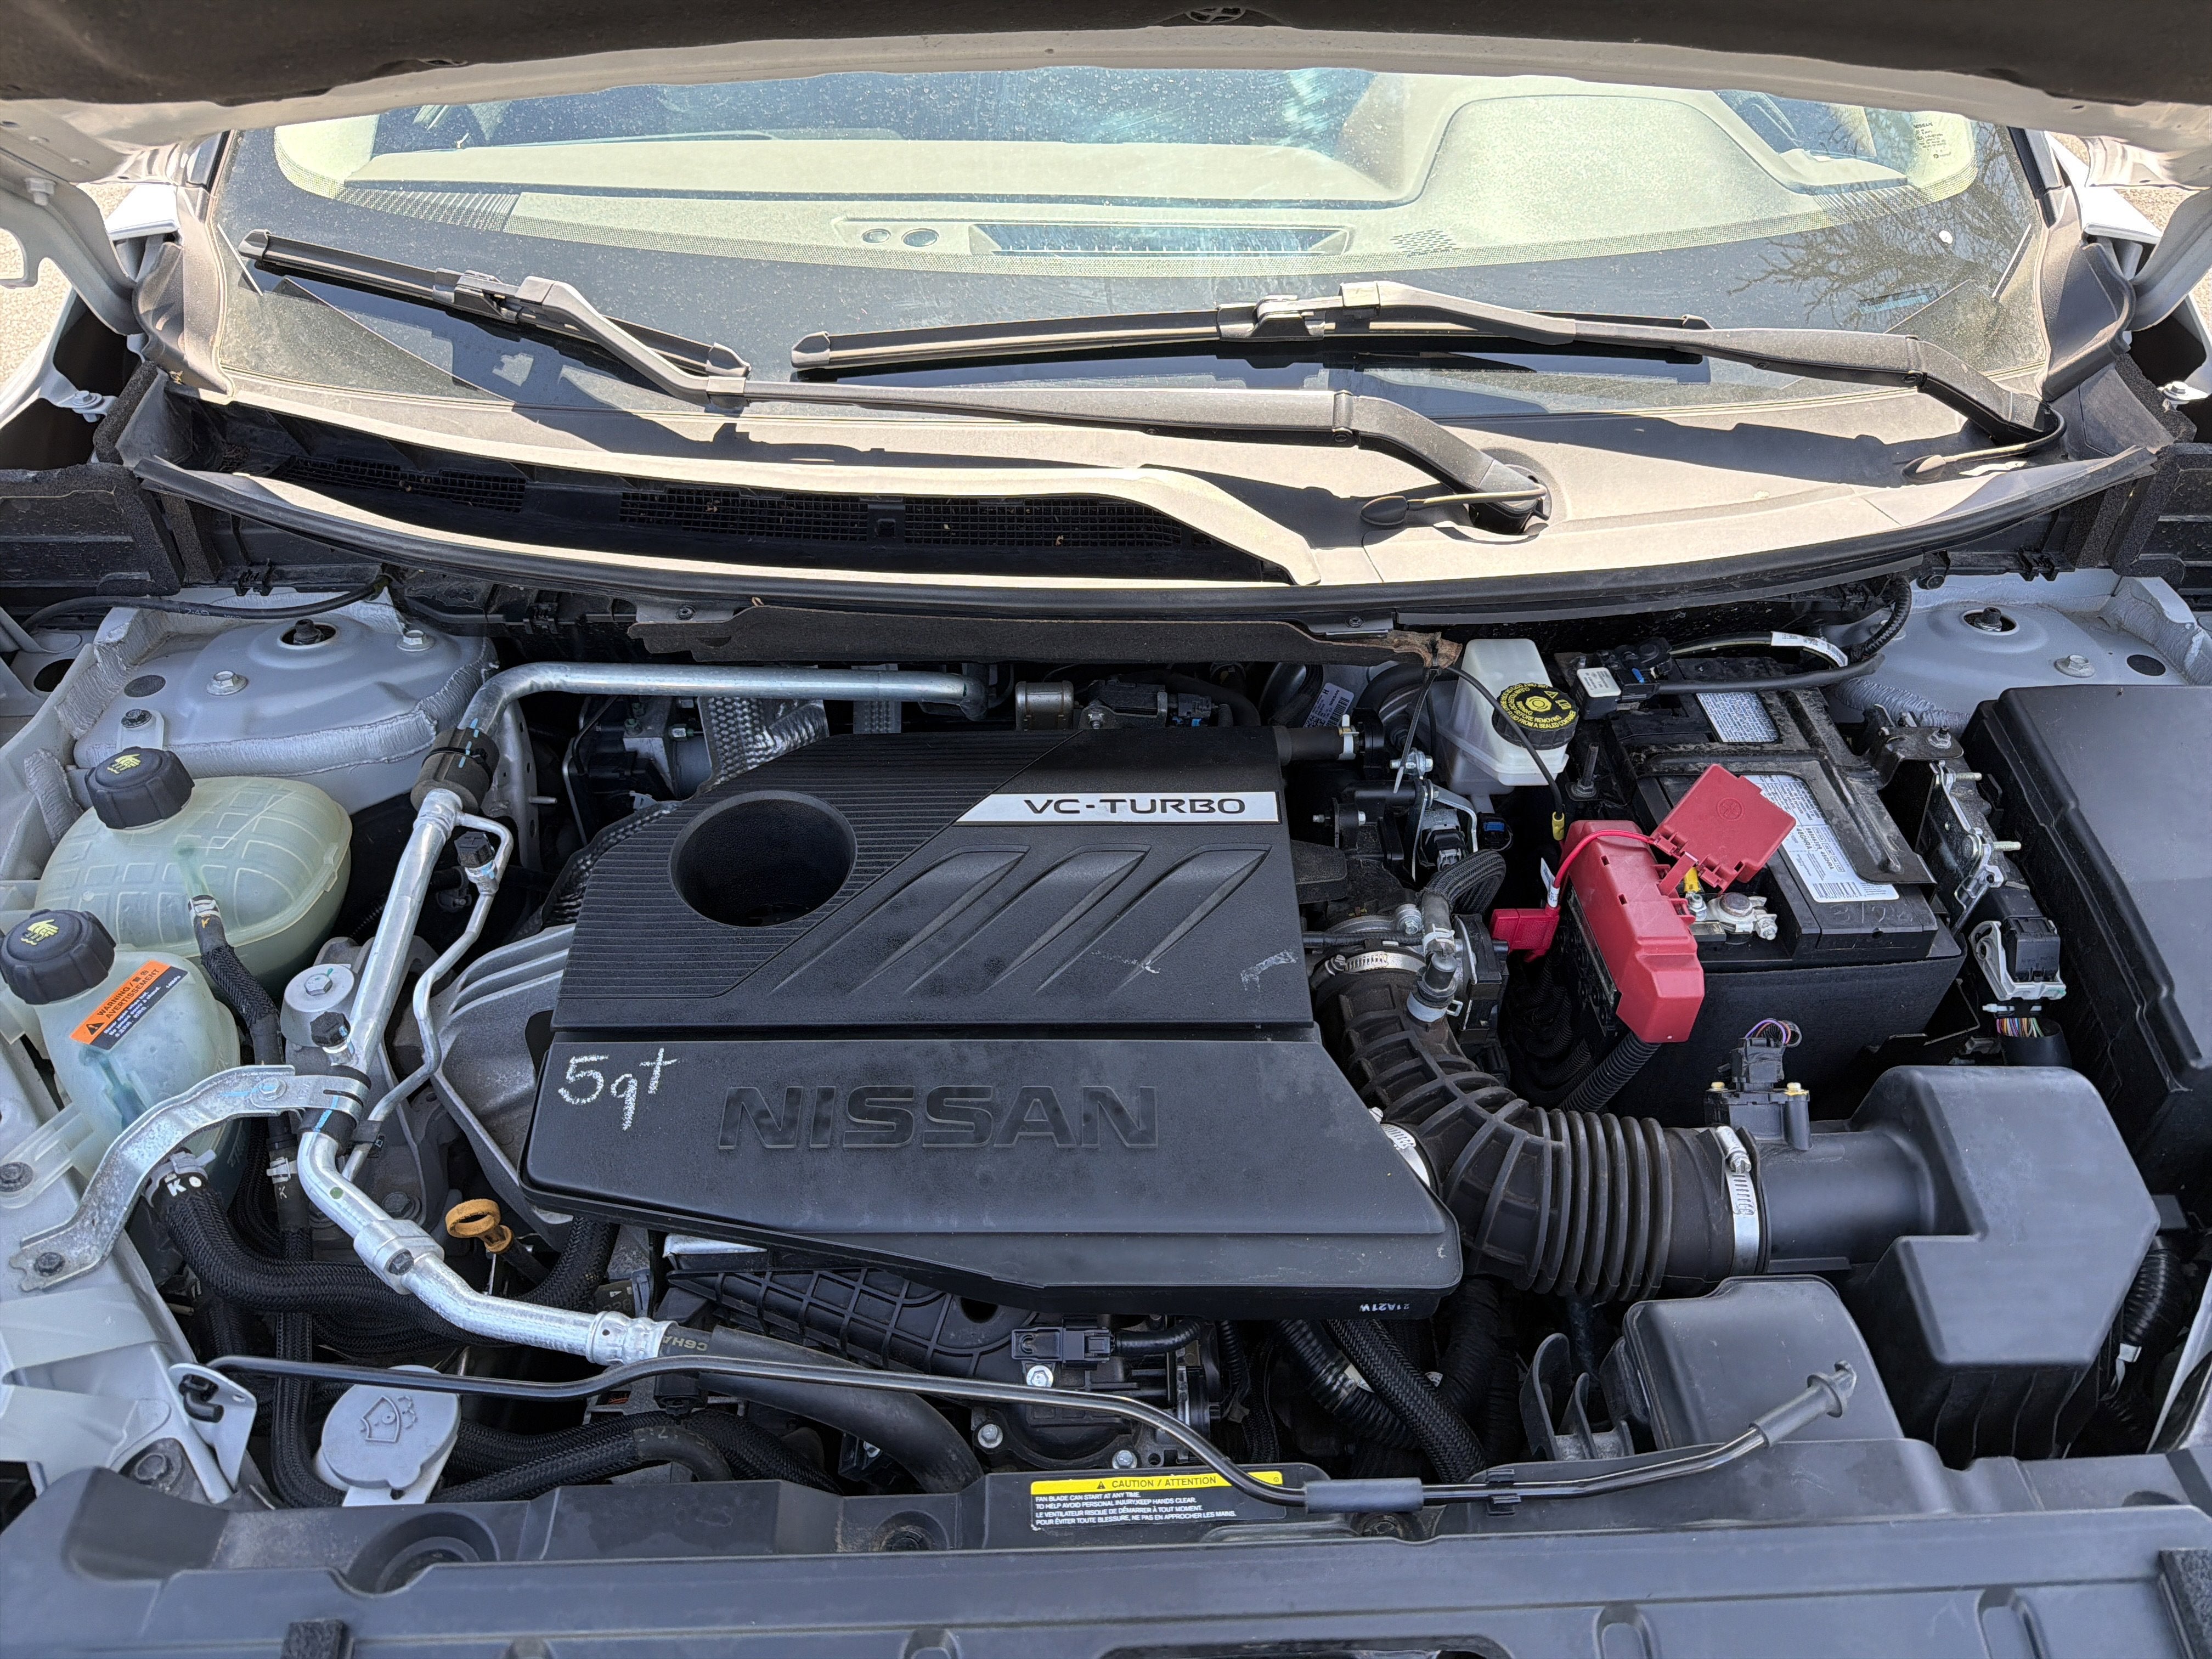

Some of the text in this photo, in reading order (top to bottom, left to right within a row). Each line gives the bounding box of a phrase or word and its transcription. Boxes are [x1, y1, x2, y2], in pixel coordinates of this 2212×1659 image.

[1514, 710, 1534, 721] BEFORE
[1517, 718, 1533, 727] FROM
[1024, 798, 1245, 814] VC-TURBO
[105, 969, 160, 1019] AVERTISSEMENT
[97, 985, 131, 1016] WARNING
[719, 1085, 1159, 1149] NISSAN
[1111, 1479, 1154, 1488] CAUTION
[1165, 1476, 1216, 1486] ATTENTION
[1119, 1506, 1151, 1514] DÉMARRER
[1055, 1516, 1076, 1525] ÉVITER
